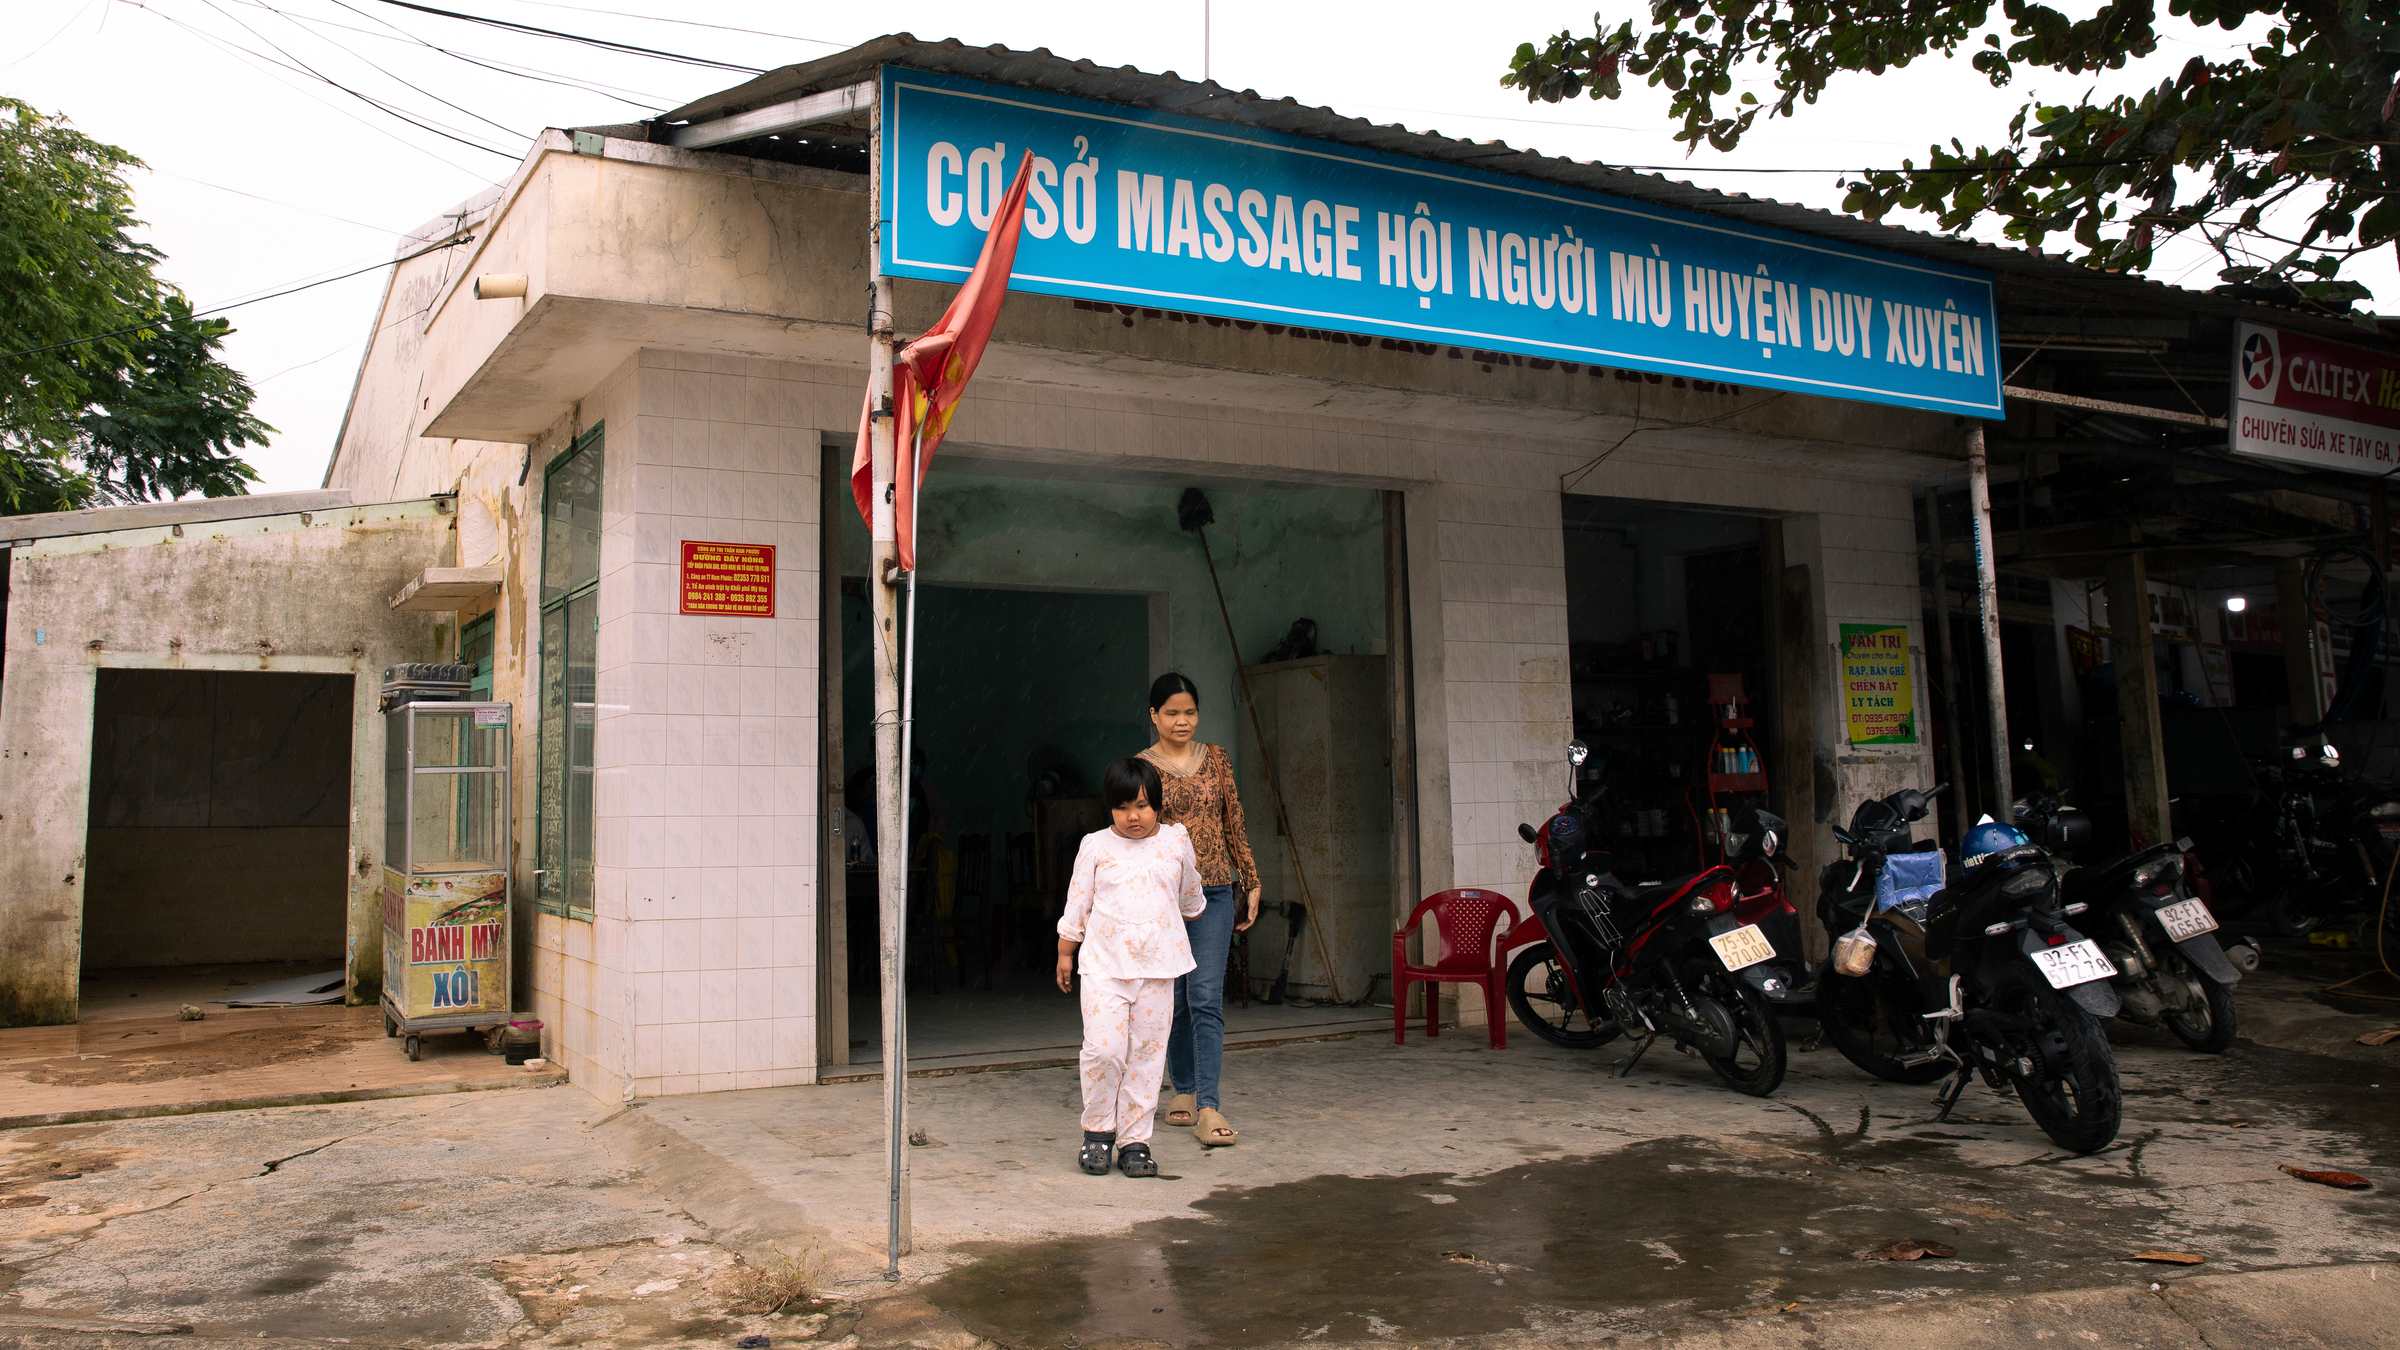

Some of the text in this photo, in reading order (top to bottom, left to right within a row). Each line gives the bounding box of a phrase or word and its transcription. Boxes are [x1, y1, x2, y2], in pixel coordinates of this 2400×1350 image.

[926, 136, 1985, 377] CƠ SỞ MASSAGE HỘI NGƯỜI MÙ HUYỆN DUY XUYÊN
[2288, 356, 2372, 405] CALTEX
[2242, 416, 2296, 446] CHUYÊN
[2300, 422, 2326, 451] SỬA
[2329, 432, 2345, 454] XE
[2349, 435, 2372, 458] TAY
[2374, 440, 2394, 466] GA,
[761, 575, 770, 583] 511
[1847, 631, 1902, 649] VĂN TRÍ
[1848, 665, 1868, 677] RẠP,
[1870, 663, 1888, 676] BÀN
[1850, 679, 1898, 691] CHÉN BÁT
[1851, 694, 1894, 707] LY TÁCH
[2164, 900, 2200, 923] 92-F1
[411, 917, 502, 965] BÁNH MỲ
[1717, 929, 1757, 952] 75-B1
[1724, 942, 1771, 968] 370.00
[2042, 943, 2092, 968] 92-F1
[2048, 957, 2111, 985] 572.78
[432, 965, 480, 1008] XÔI
